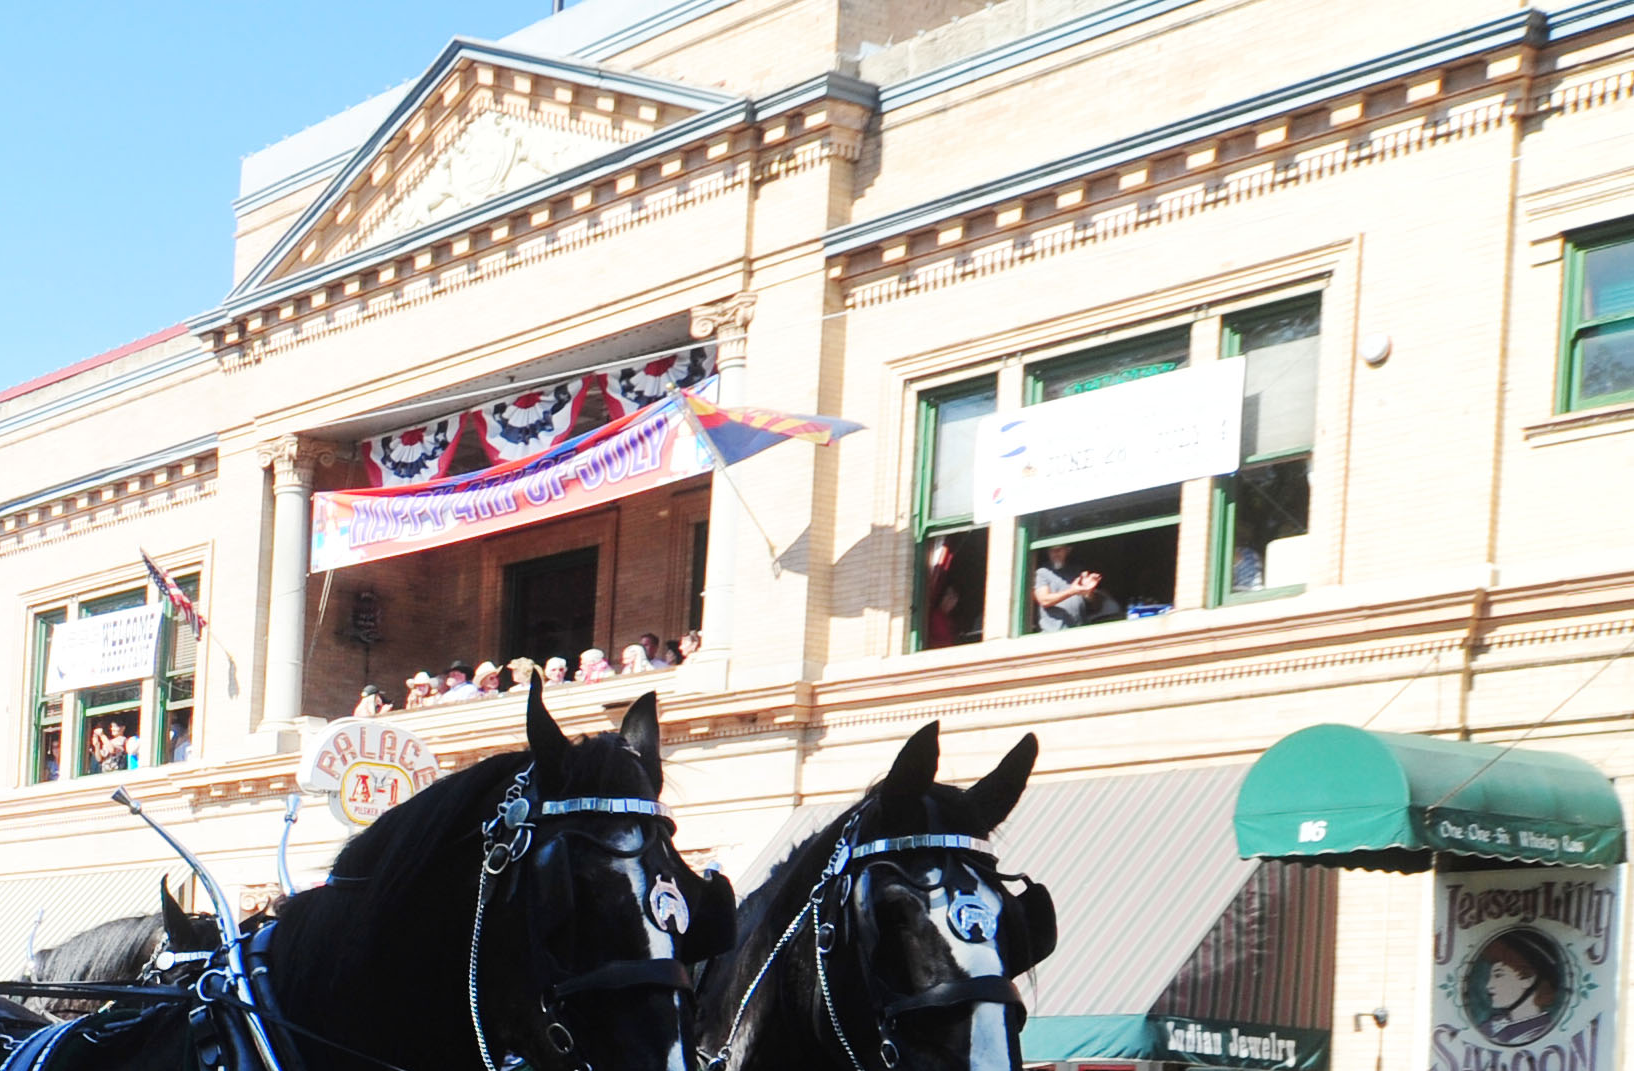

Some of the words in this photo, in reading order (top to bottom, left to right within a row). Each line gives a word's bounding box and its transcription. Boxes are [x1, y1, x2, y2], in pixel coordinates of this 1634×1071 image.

[349, 486, 453, 548] HAPPY
[451, 471, 522, 522] 4TH
[524, 449, 578, 506] OF
[575, 414, 669, 490] JULY
[317, 726, 438, 790] PALACE
[349, 774, 399, 806] A-1
[1434, 883, 1541, 966] Jersey
[1166, 1021, 1223, 1055] Indian
[1229, 1028, 1296, 1067] Jewelry
